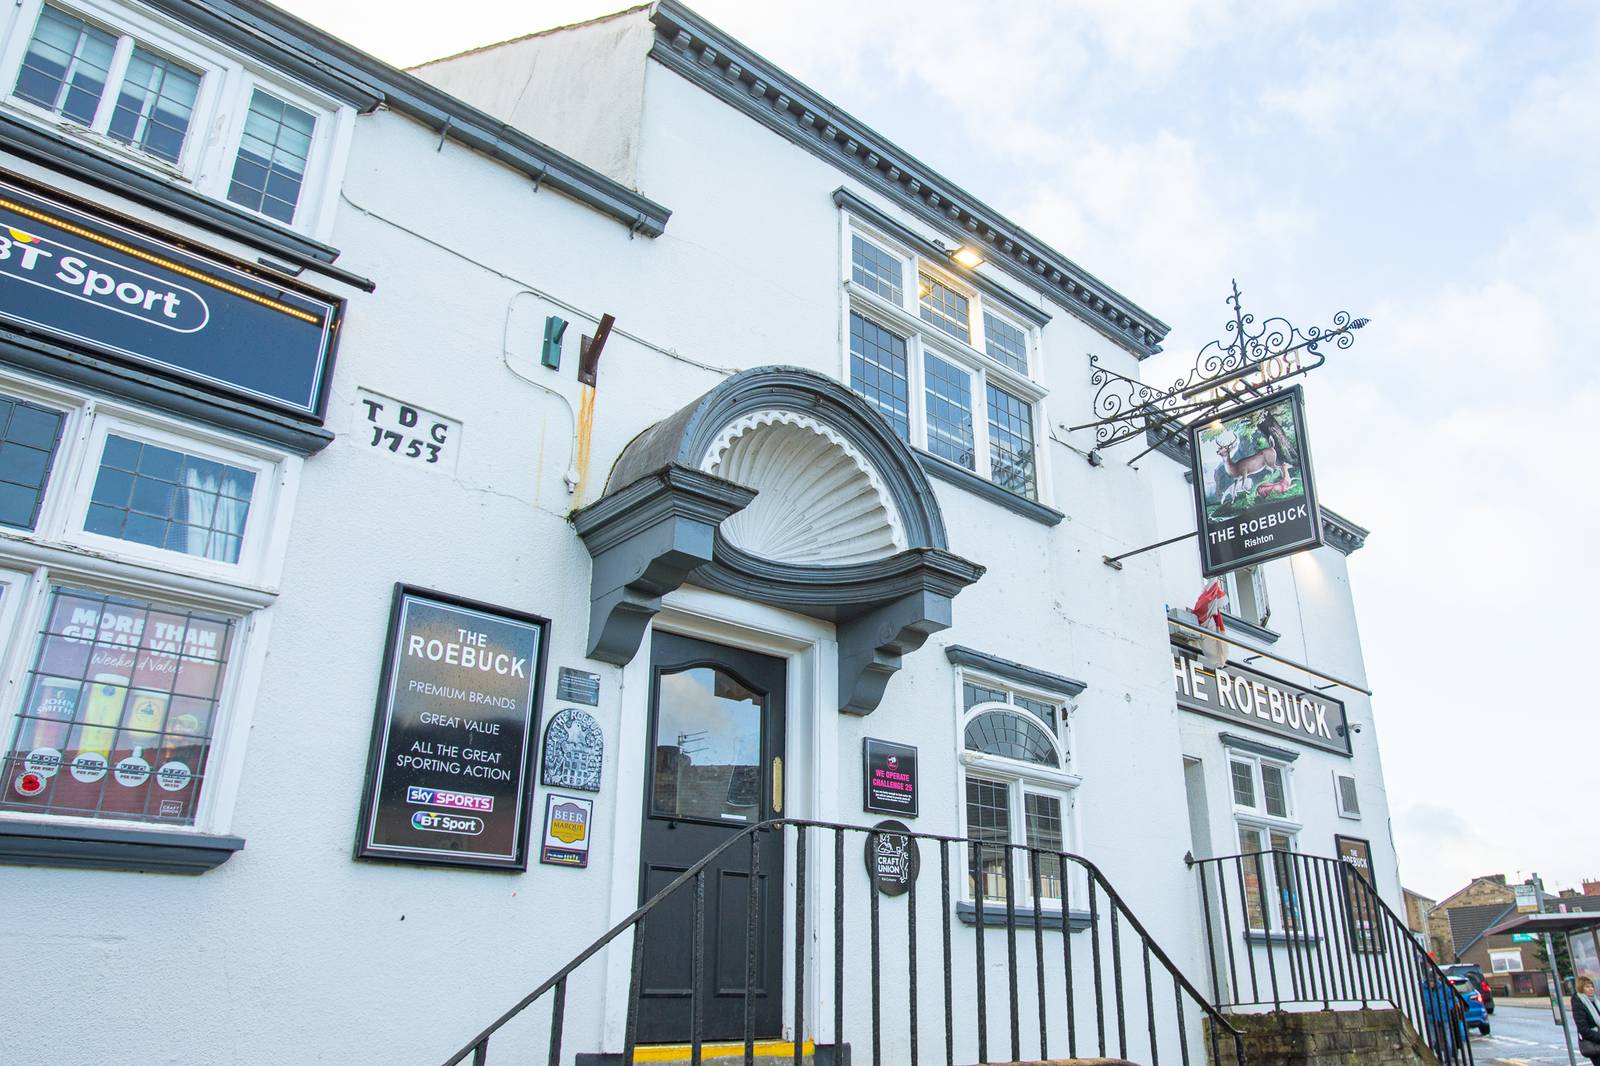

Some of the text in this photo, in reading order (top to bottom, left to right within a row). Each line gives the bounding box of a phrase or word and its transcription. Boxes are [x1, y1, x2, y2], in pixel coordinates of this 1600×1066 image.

[0, 235, 181, 319] BT Sport
[362, 399, 448, 445] T D G
[371, 426, 442, 463] 1753
[1209, 504, 1308, 545] THE ROEBUCK
[1244, 533, 1274, 549] Rishton
[70, 607, 218, 648] MORE THAN
[458, 629, 488, 648] THE
[62, 625, 218, 666] GREAT VALUE
[408, 635, 527, 679] ROEBUCK
[408, 680, 516, 710] PREMIUM BRANDS
[1173, 653, 1332, 740] HE ROEBUCK
[420, 711, 500, 735] GREAT VALUE
[411, 740, 502, 764] ALL THE GREAT
[396, 754, 511, 781] SPORTING ACTION
[875, 769, 910, 782] WE OPERATE
[872, 778, 913, 792] CHALLENGE 25
[411, 789, 491, 809] sky SPORTS
[420, 815, 476, 831] BT Sport
[555, 809, 584, 823] BEER
[878, 856, 900, 866] CRAFT
[878, 864, 900, 874] UNION
